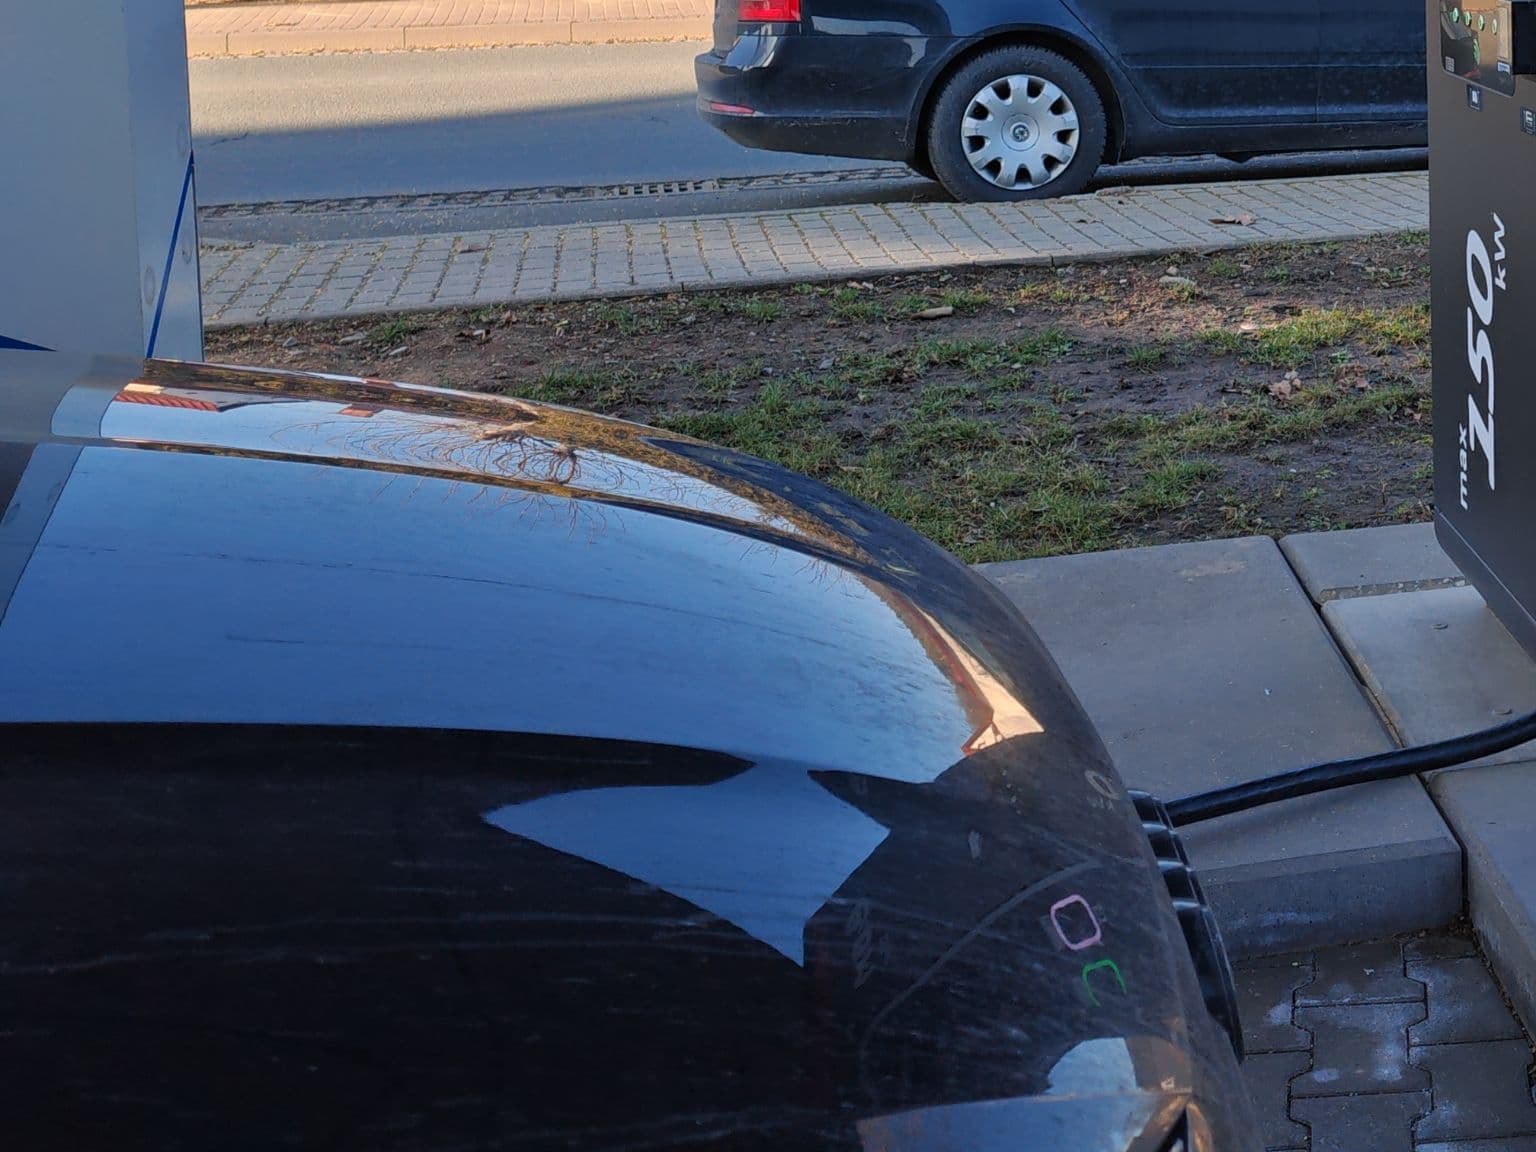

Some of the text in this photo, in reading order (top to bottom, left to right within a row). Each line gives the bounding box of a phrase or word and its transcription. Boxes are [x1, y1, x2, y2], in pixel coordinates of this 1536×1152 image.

[1458, 212, 1507, 510] max 150 kW
